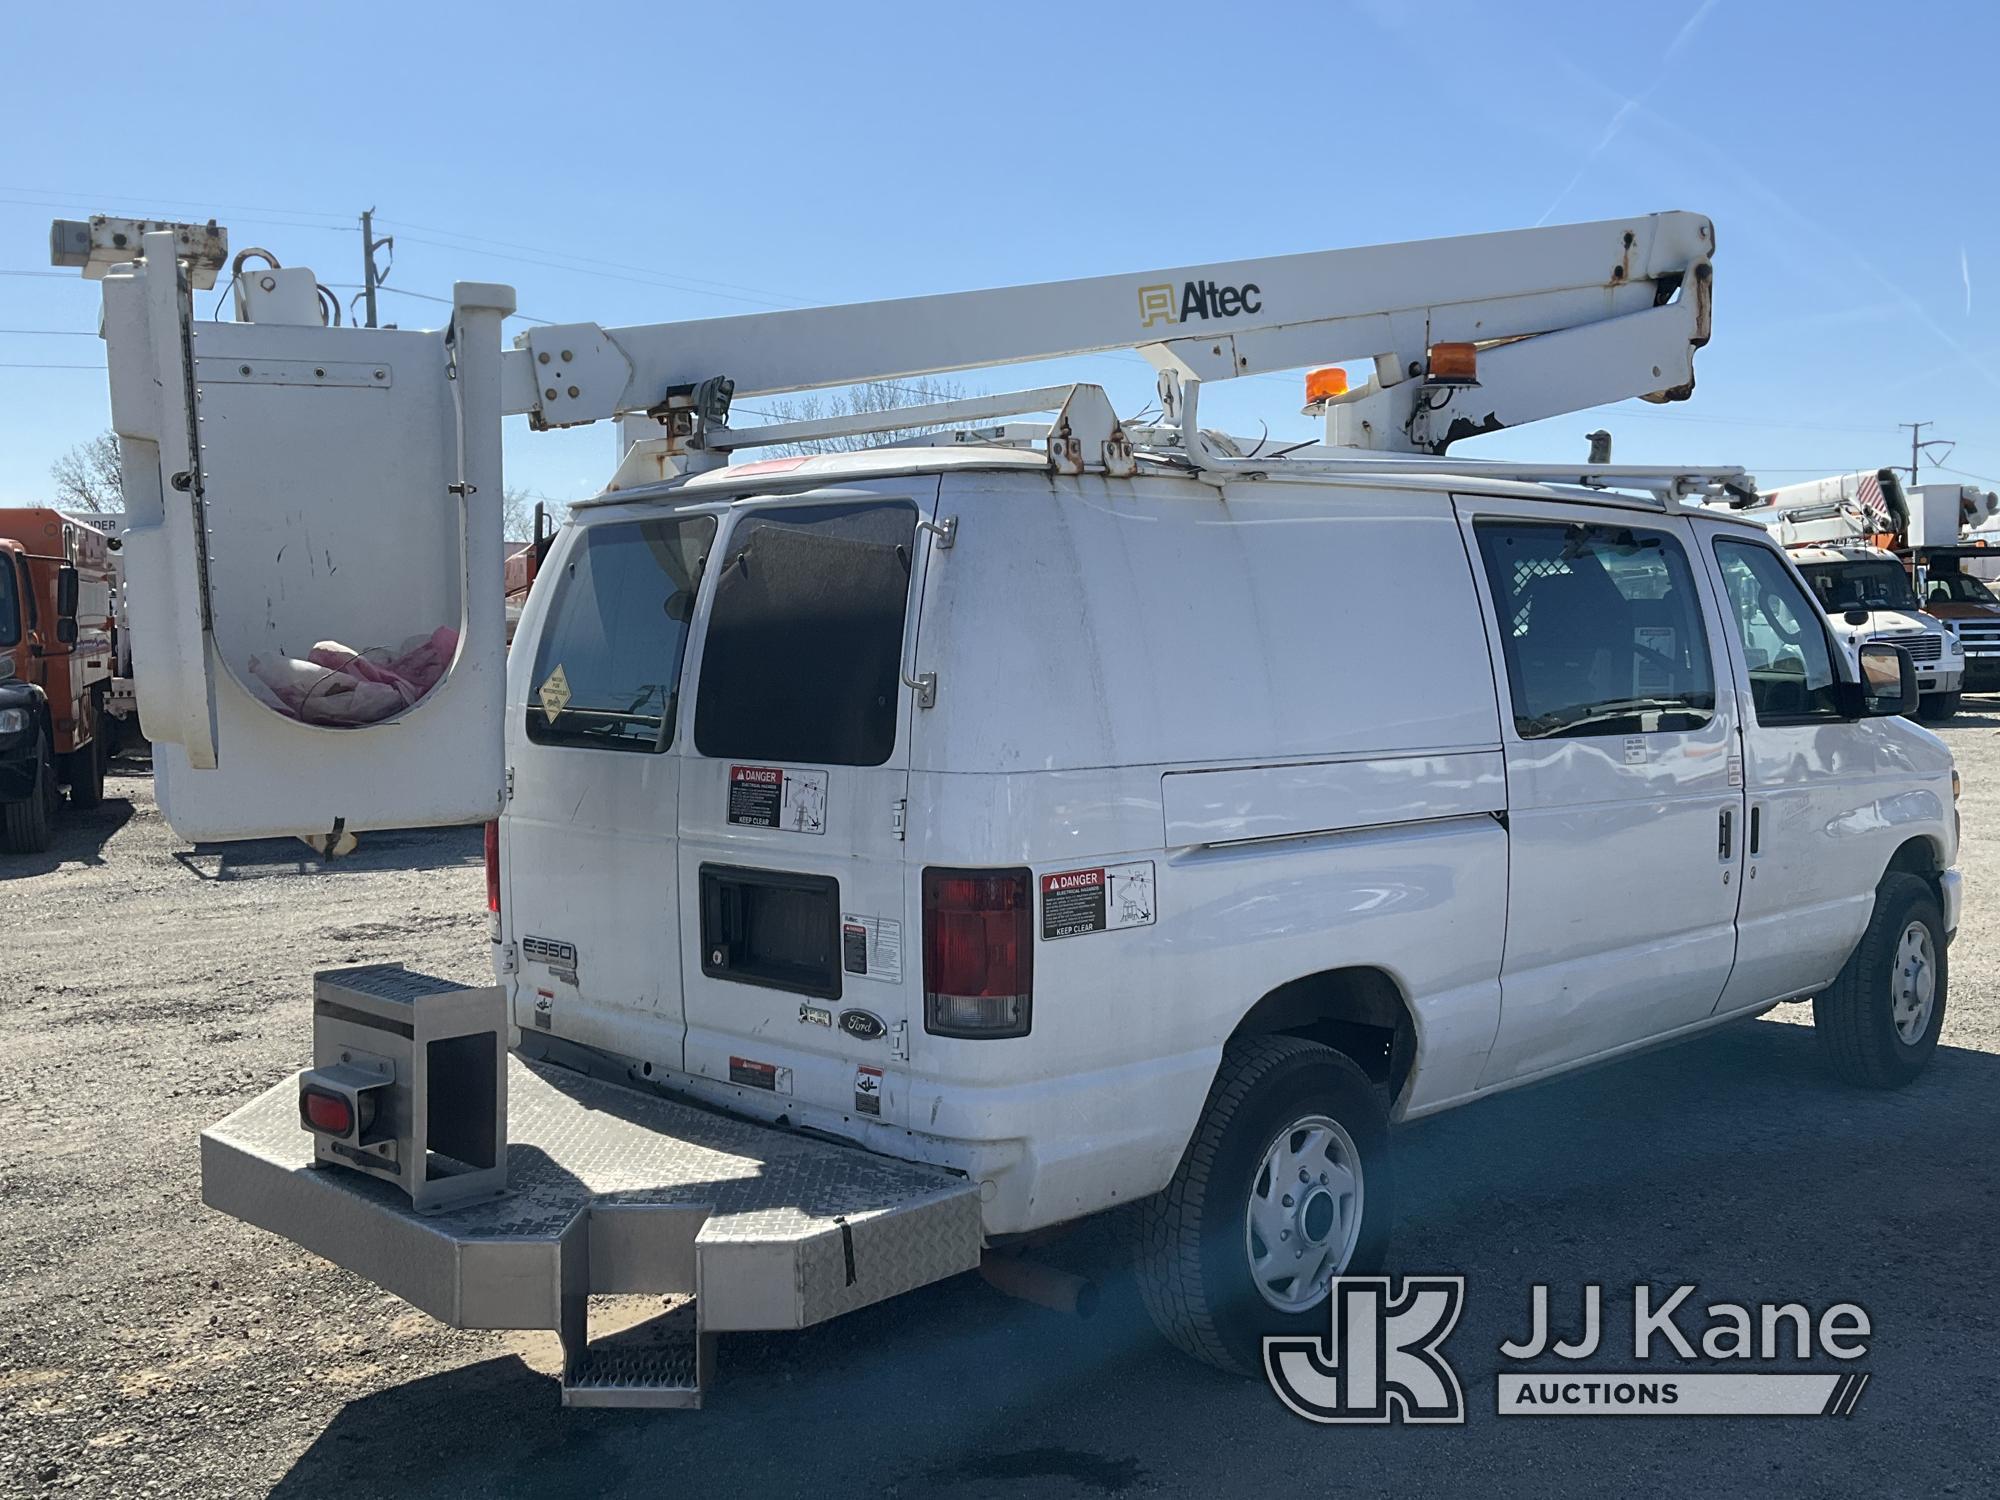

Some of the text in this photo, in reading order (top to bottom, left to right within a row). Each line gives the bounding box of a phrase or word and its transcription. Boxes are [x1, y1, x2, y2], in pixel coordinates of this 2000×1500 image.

[1179, 280, 1262, 322] Altec
[745, 770, 776, 782] DANGER
[739, 816, 769, 825] KEEP CLEAR
[1061, 873, 1097, 888] DANGER
[1056, 888, 1080, 896] ELECTRICAL
[1056, 923, 1093, 936] KEEP CLEAR
[848, 1014, 872, 1033] Ford
